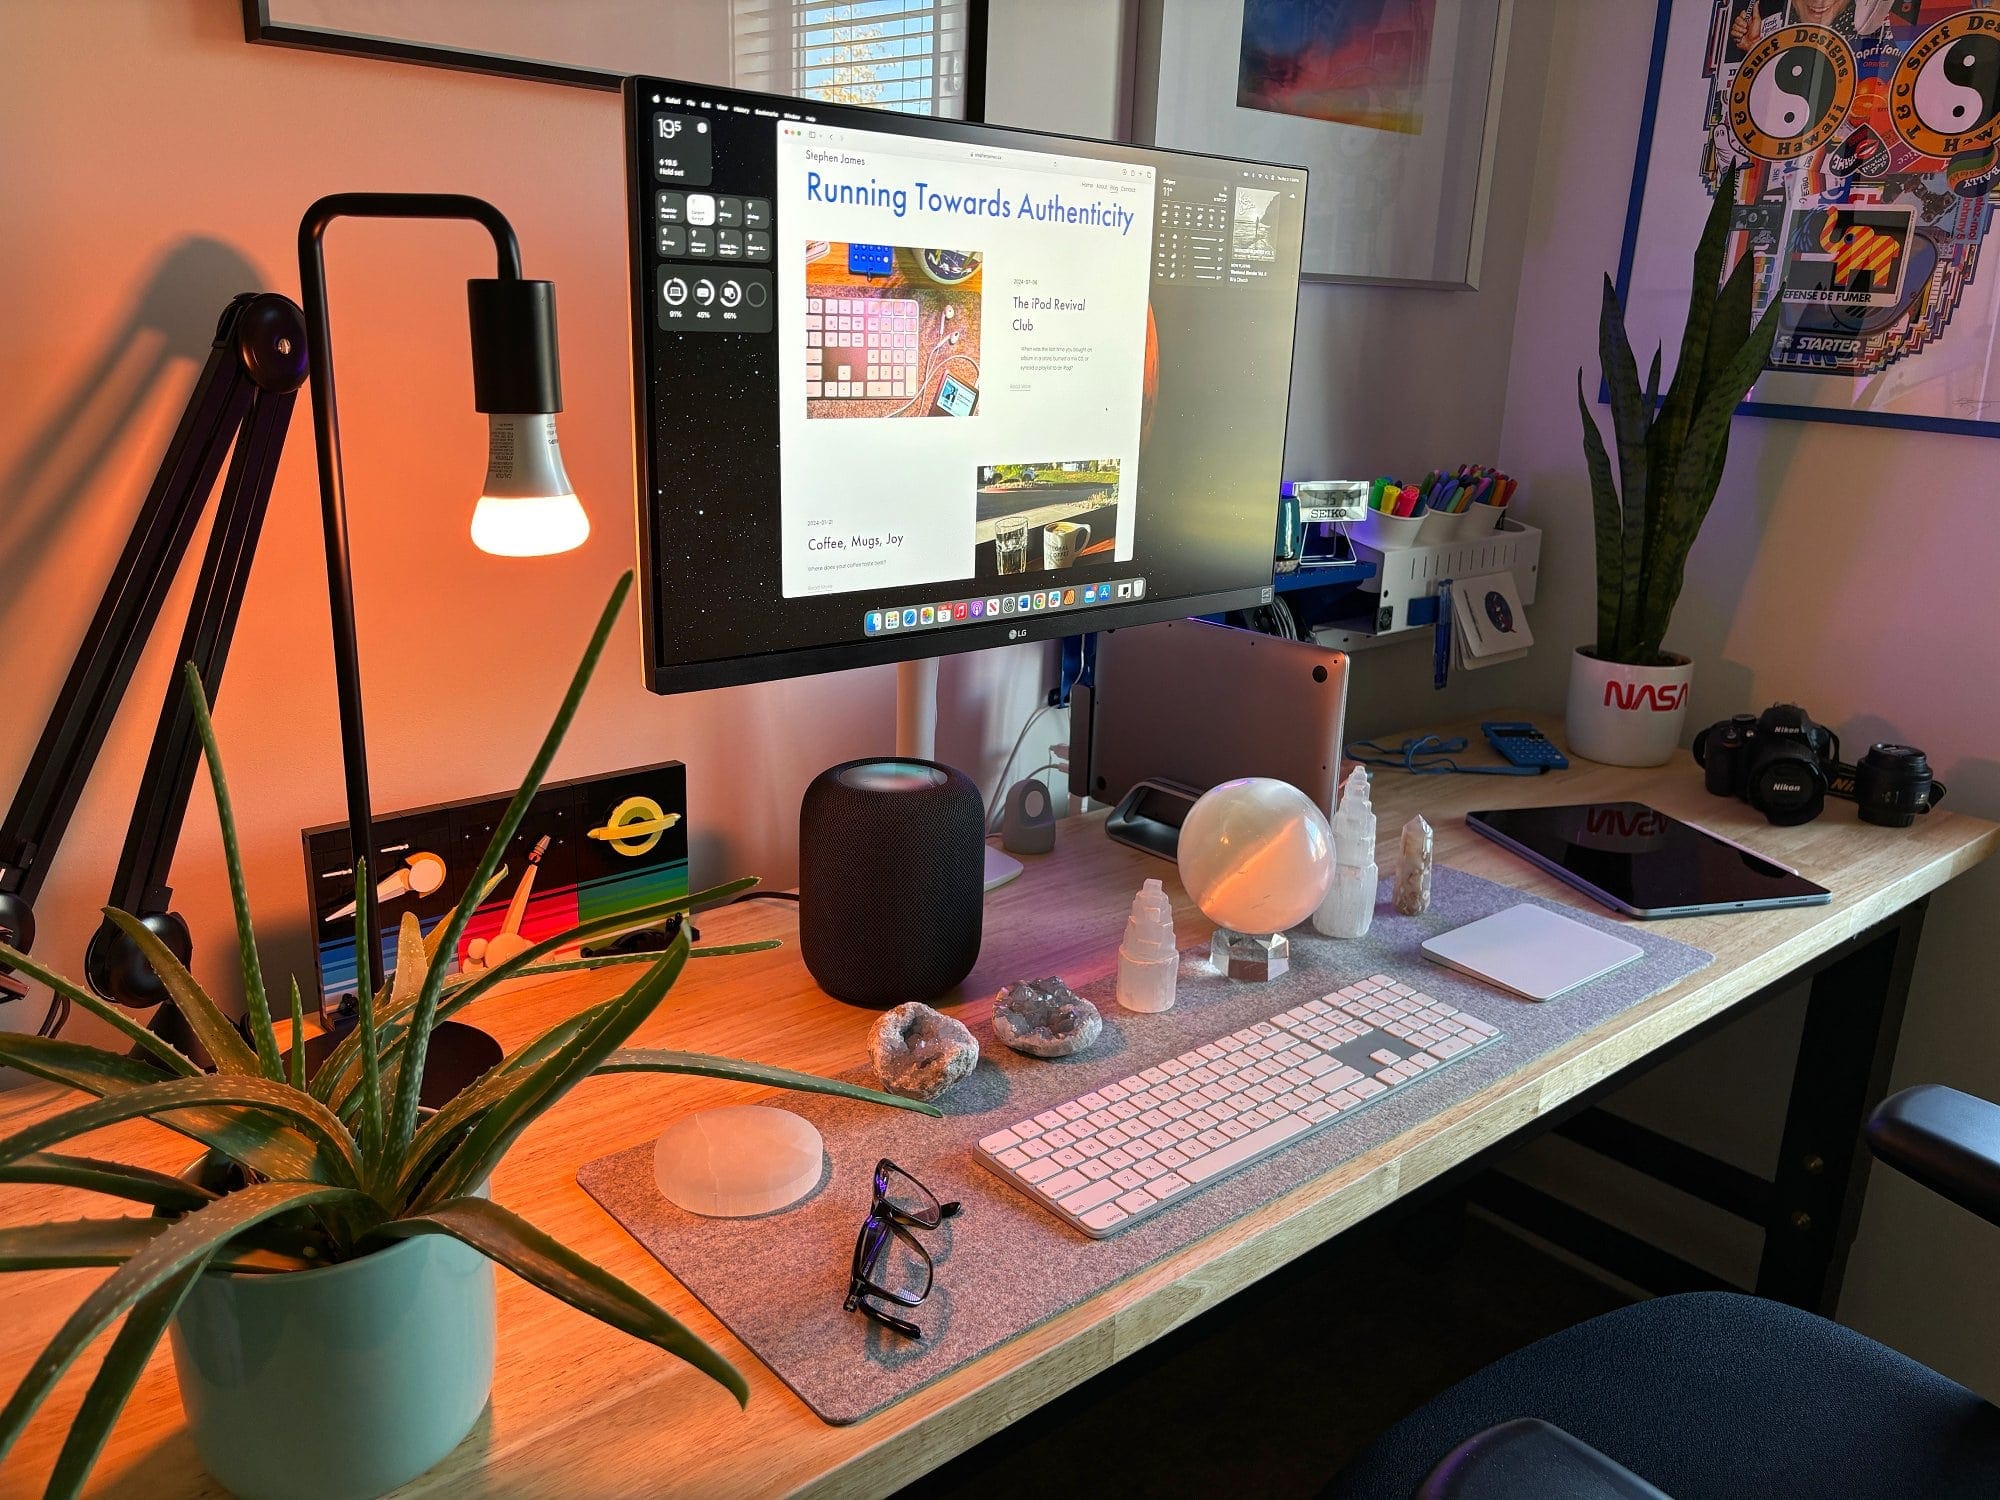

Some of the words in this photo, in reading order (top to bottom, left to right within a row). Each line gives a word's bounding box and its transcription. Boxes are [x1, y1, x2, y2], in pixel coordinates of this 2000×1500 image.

[1743, 38, 1780, 79] Surf
[1794, 29, 1849, 78] Designs
[1907, 25, 1951, 70] Surf
[1776, 105, 1845, 155] Hawaii
[806, 150, 838, 165] Stephen
[840, 154, 866, 166] James
[1963, 165, 2000, 189] BALLY
[807, 172, 906, 217] Running
[916, 183, 1010, 218] Towards
[1018, 194, 1134, 235] Authenticity
[1013, 297, 1029, 309] The
[1032, 298, 1051, 309] iPod
[1054, 299, 1086, 311] Revival
[1783, 290, 1817, 302] EFENSE
[1820, 291, 1833, 302] DE
[1836, 292, 1872, 303] FUMER
[1013, 319, 1033, 331] Club
[1797, 336, 1861, 353] STARTER
[1310, 508, 1347, 519] SEIKO
[808, 537, 846, 550] Coffee,
[851, 536, 882, 549] Mugs,
[886, 533, 903, 547] Joy
[1604, 680, 1688, 712] NASA
[1774, 726, 1800, 734] Nikon
[1773, 782, 1800, 792] Nikon
